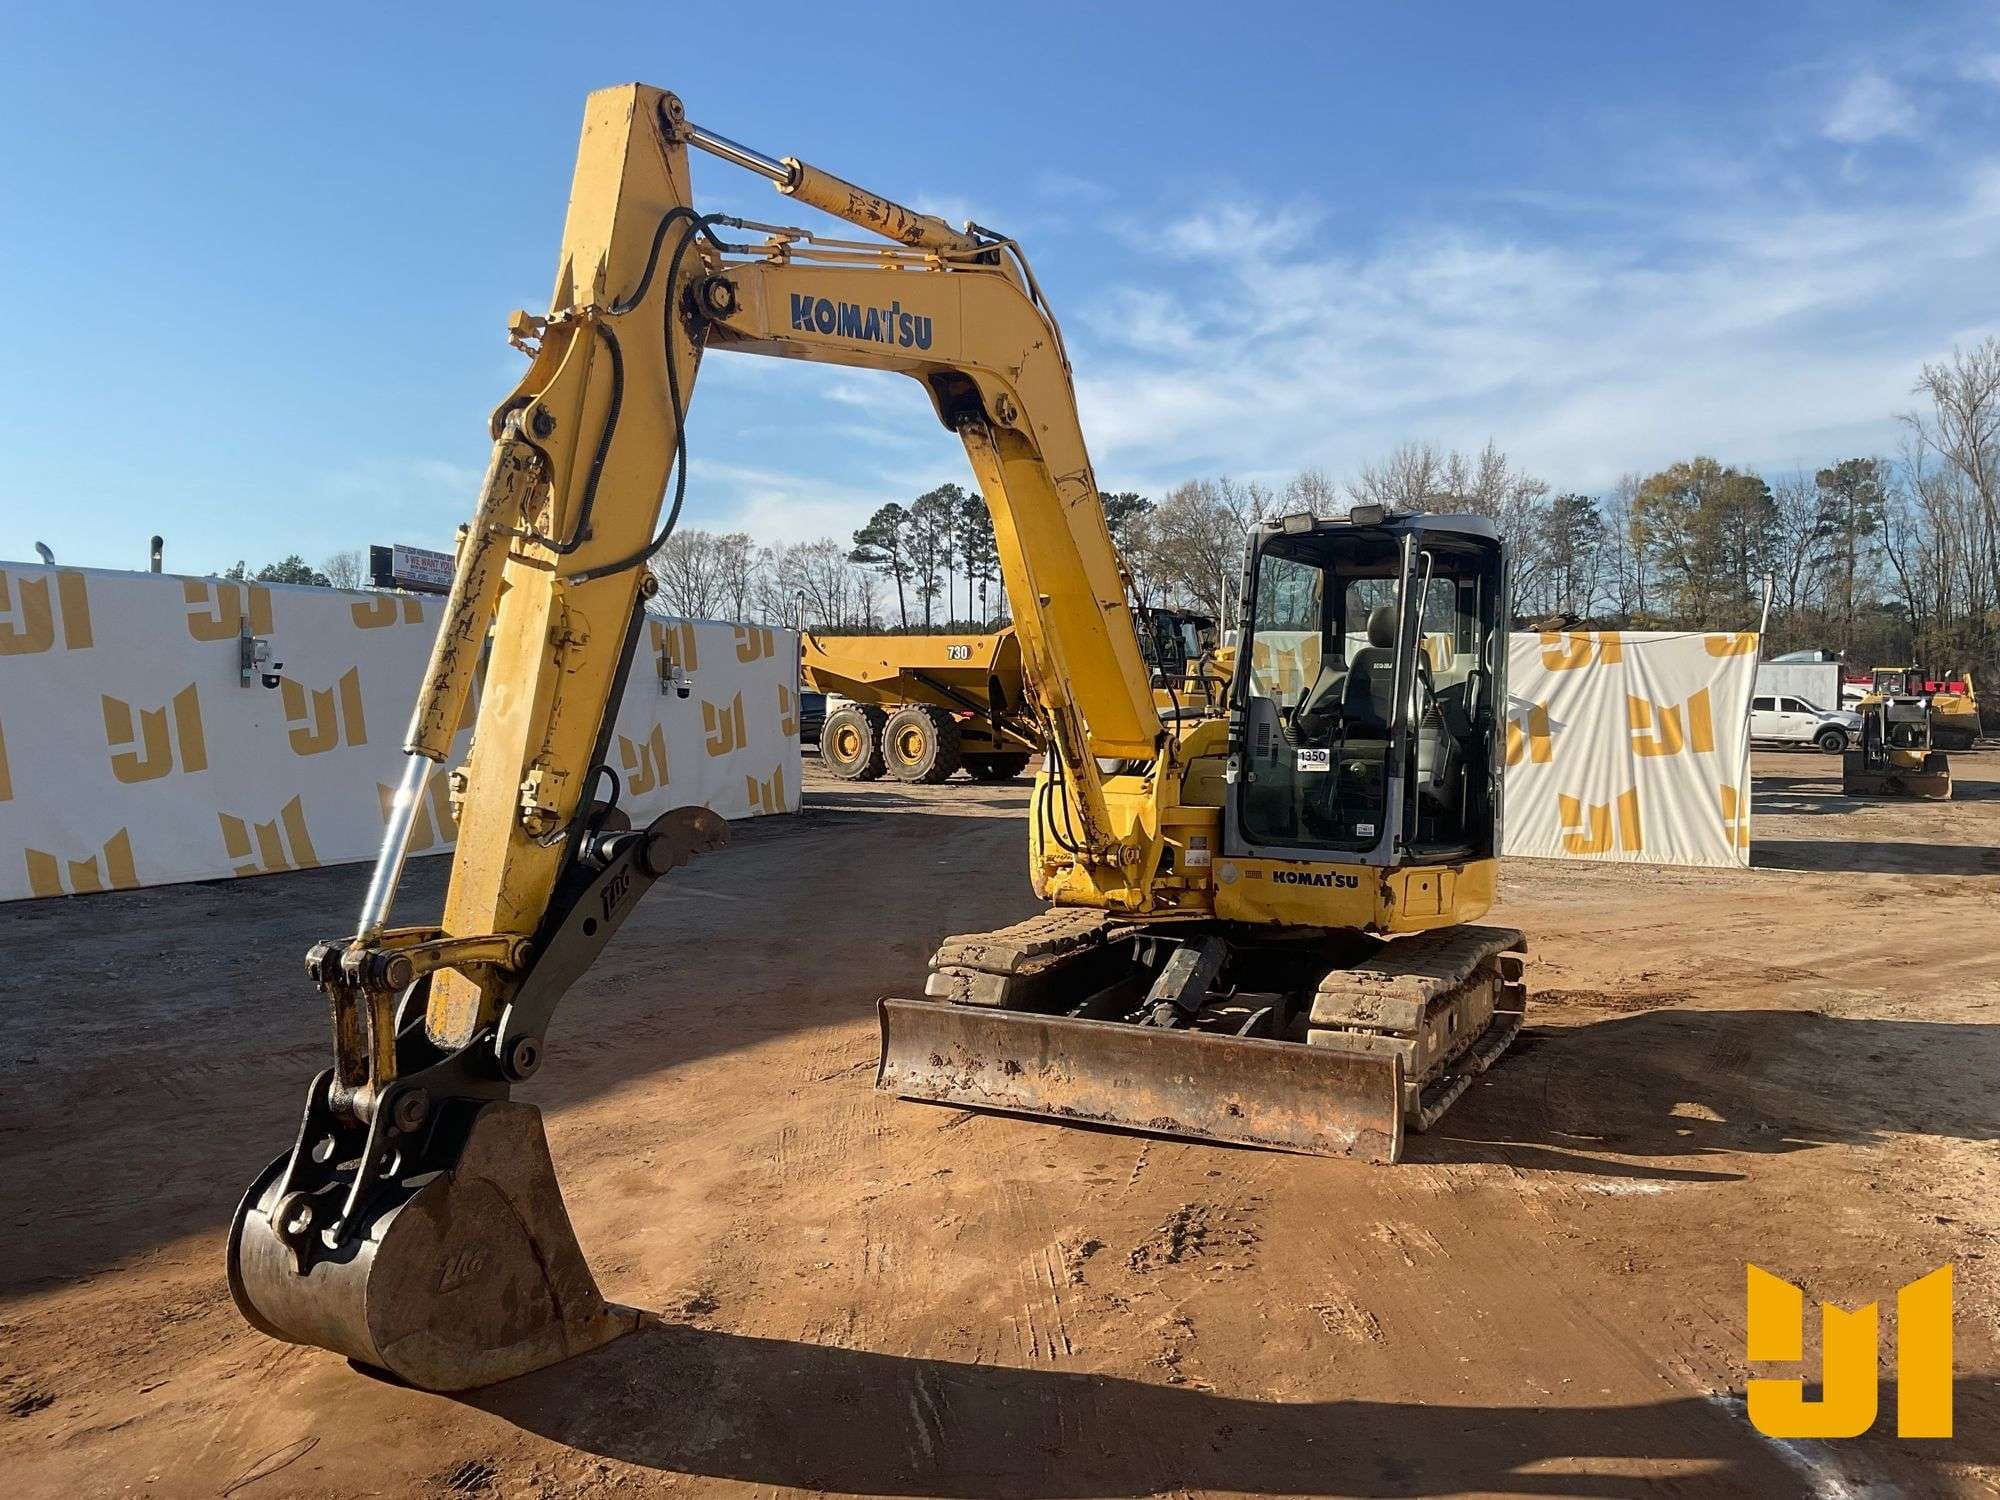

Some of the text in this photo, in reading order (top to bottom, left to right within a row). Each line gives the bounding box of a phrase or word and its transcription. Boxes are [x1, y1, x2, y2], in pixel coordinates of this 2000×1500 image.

[790, 293, 932, 350] KOMATSU
[947, 645, 968, 660] 730
[1301, 751, 1326, 761] 1350
[1272, 871, 1358, 888] KOMATSU
